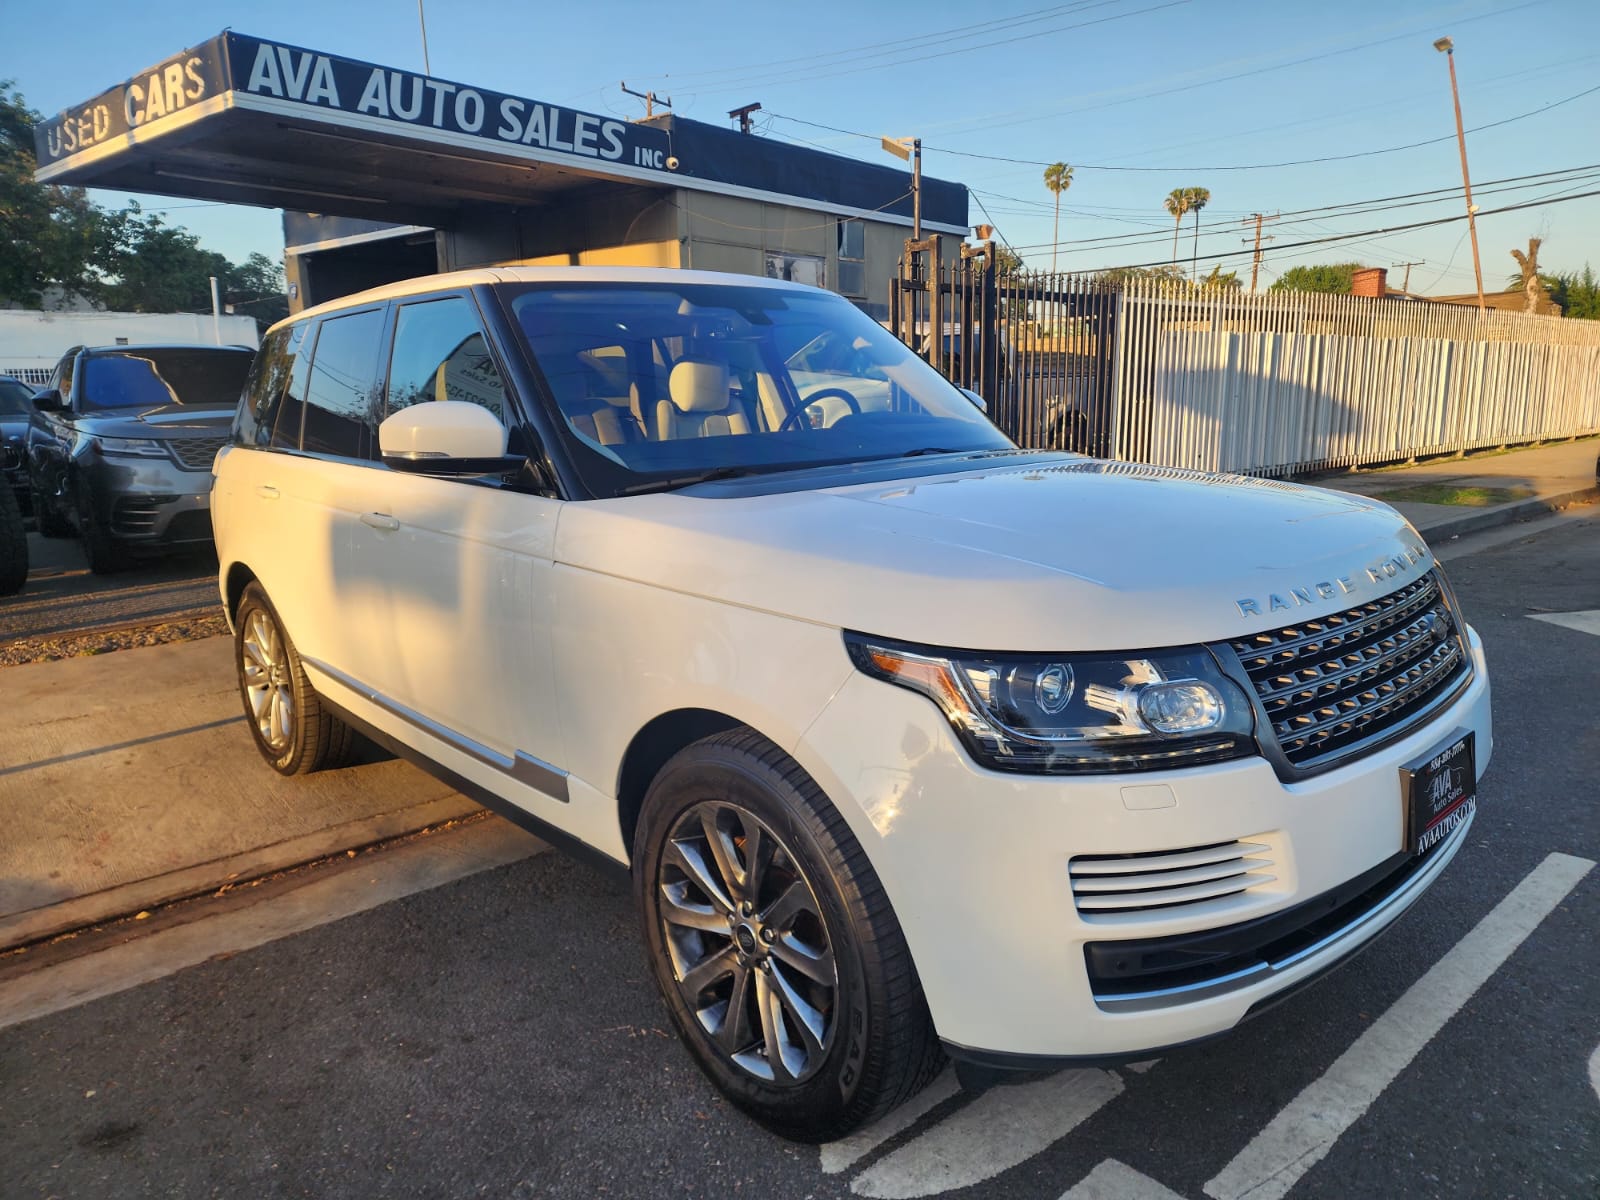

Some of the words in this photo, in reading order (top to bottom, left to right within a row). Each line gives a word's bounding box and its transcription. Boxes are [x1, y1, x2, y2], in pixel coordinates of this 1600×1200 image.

[48, 105, 109, 157] USED
[125, 57, 205, 127] CARS
[247, 43, 341, 107] AVA
[357, 68, 485, 132] AUTO
[498, 98, 626, 160] SALES
[634, 146, 663, 169] INC
[1234, 577, 1355, 618] RANGE
[1433, 768, 1452, 801] AVA
